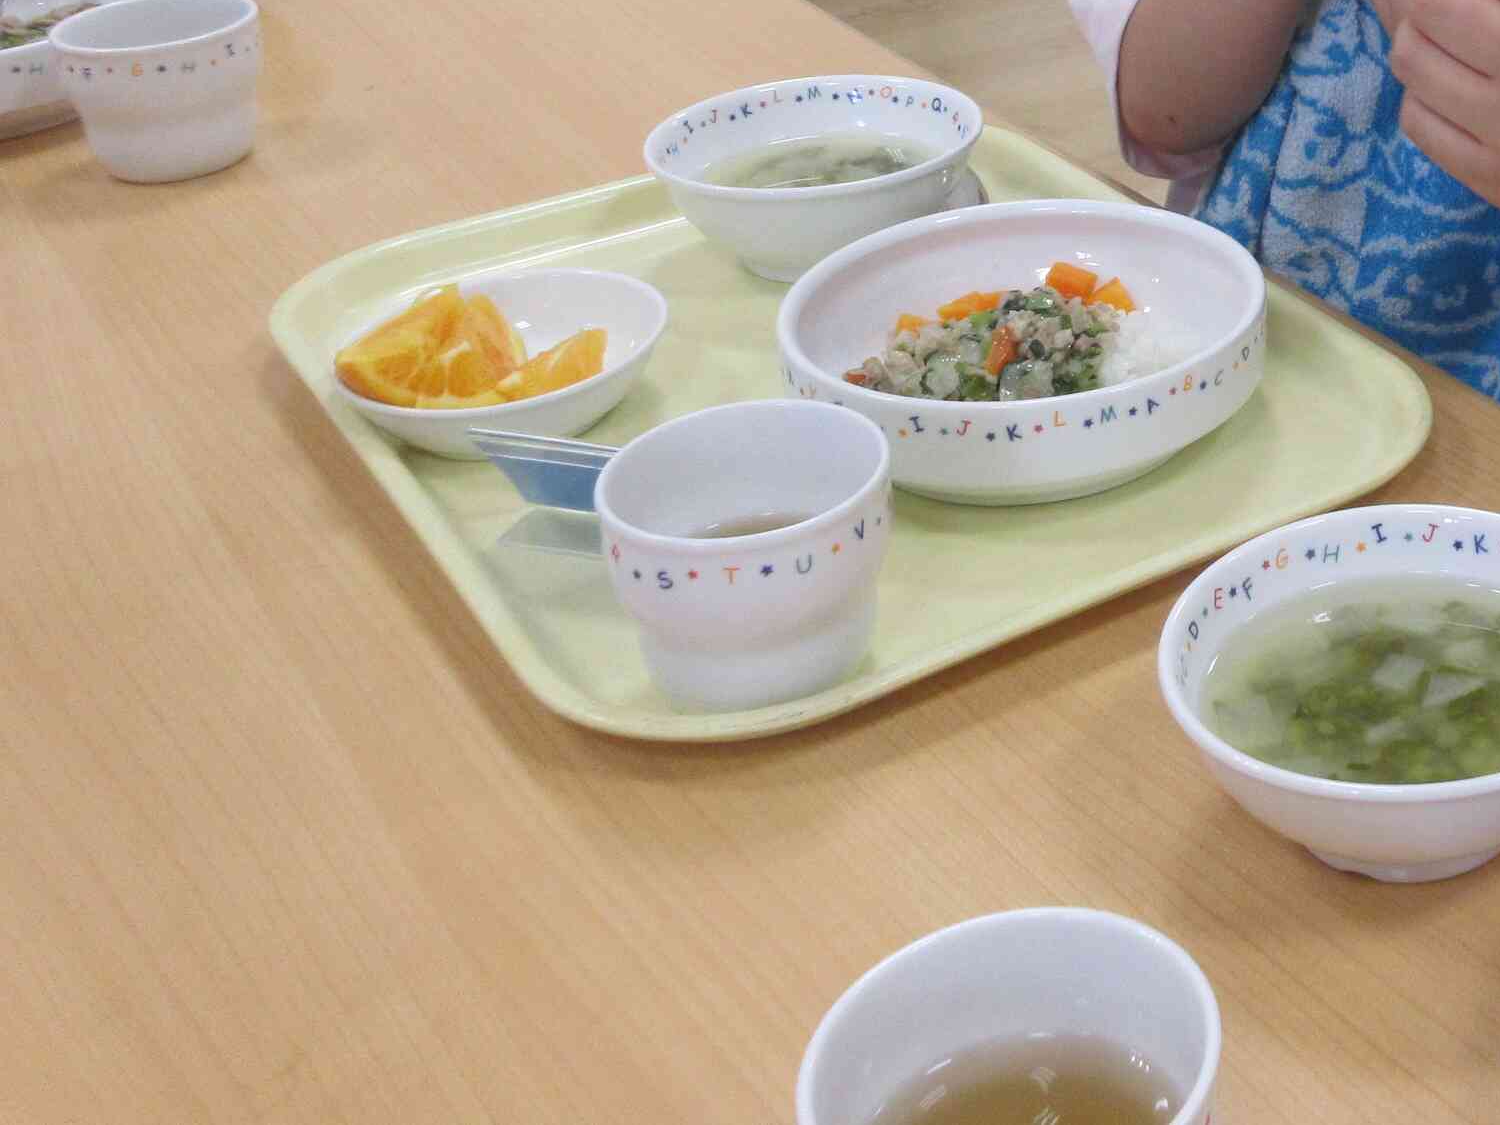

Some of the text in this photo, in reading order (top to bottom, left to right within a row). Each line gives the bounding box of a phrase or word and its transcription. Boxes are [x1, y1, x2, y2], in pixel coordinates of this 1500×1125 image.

[741, 103, 753, 118] K
[774, 90, 783, 103] L
[808, 86, 821, 101] M
[880, 86, 893, 99] O
[931, 97, 942, 114] Q
[910, 416, 925, 432] I
[956, 420, 971, 437] J
[1006, 425, 1022, 442] K
[1054, 410, 1065, 428] L
[1100, 405, 1117, 424] M
[1147, 398, 1160, 415] A
[1183, 374, 1192, 391] B
[657, 571, 673, 589] S
[724, 567, 740, 584] T
[796, 554, 812, 574] U
[1214, 587, 1223, 610] E
[1242, 577, 1253, 601] F
[1276, 548, 1289, 568] G
[1322, 545, 1340, 563] H
[1373, 524, 1387, 543] I
[1422, 524, 1440, 543] J
[1473, 534, 1489, 555] K
